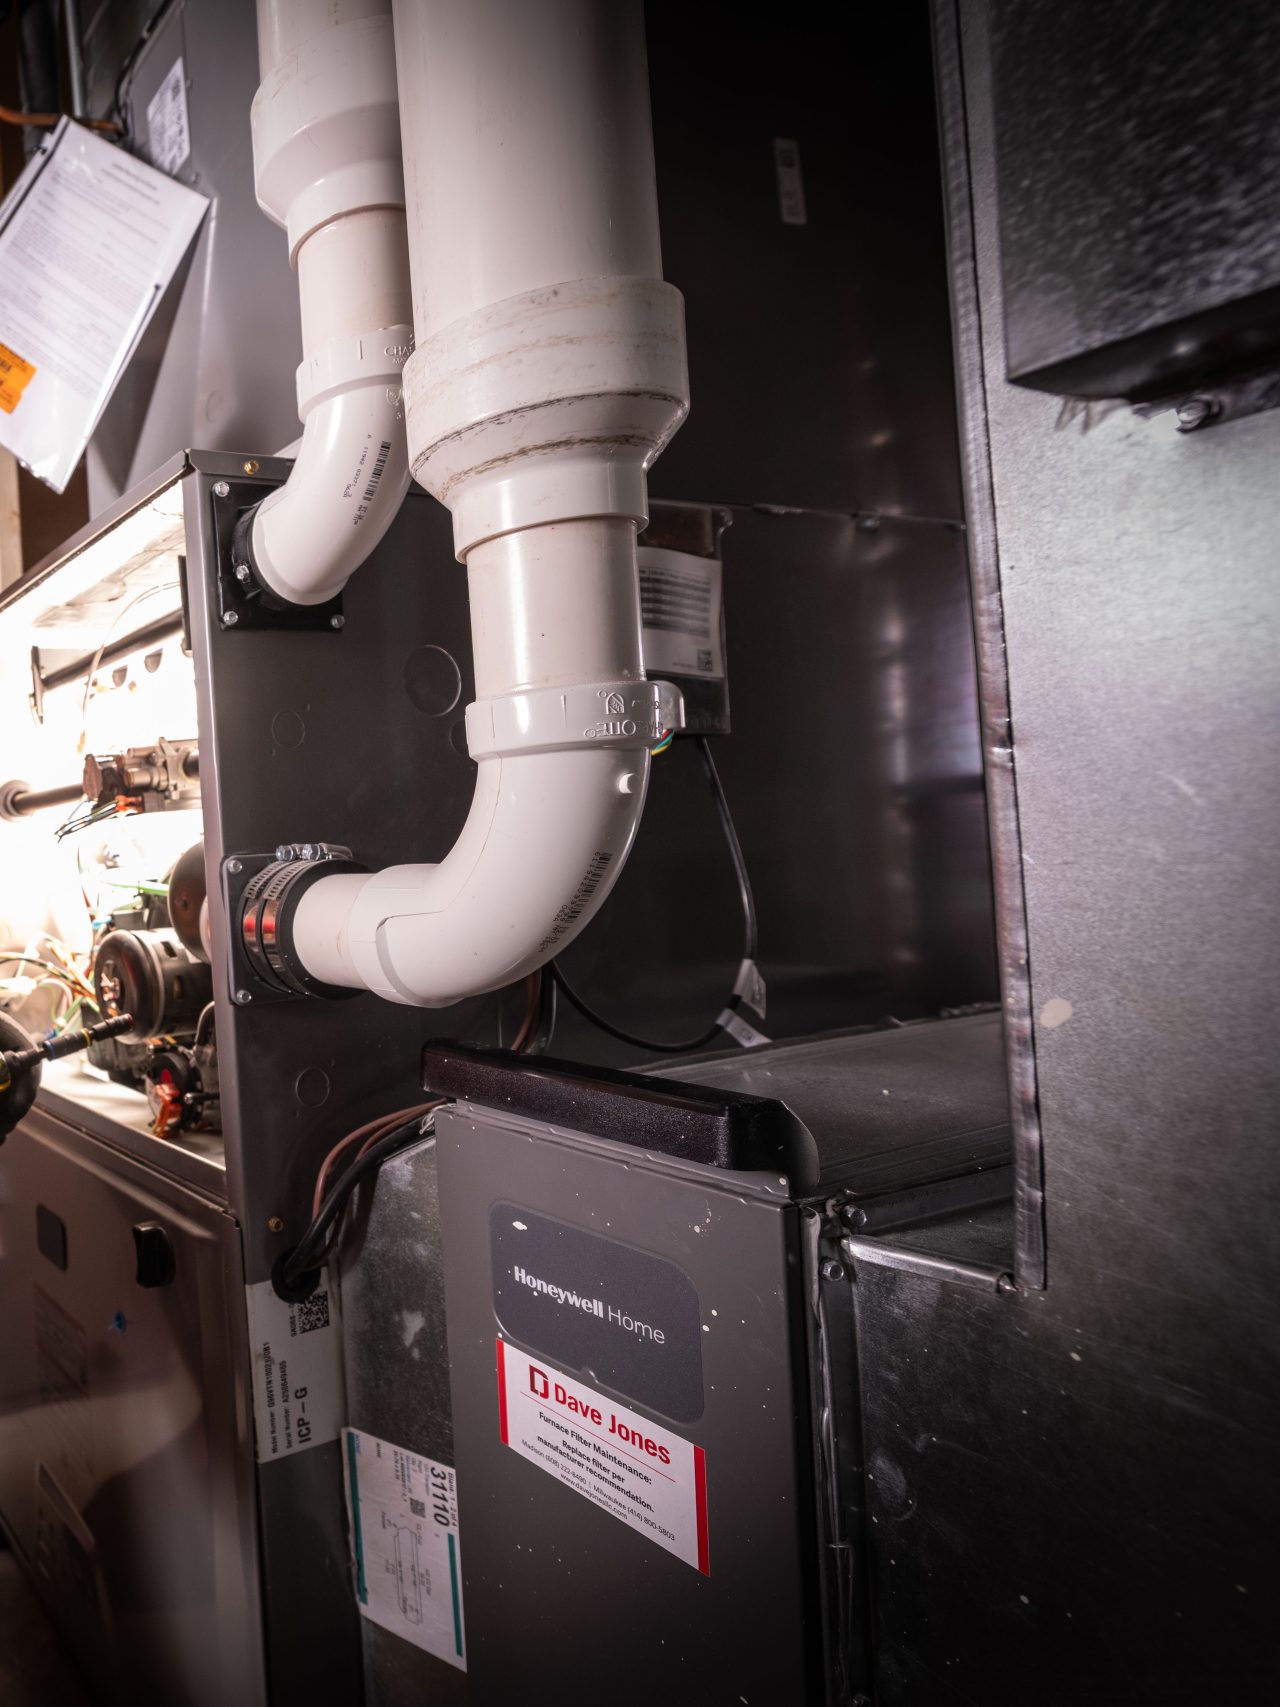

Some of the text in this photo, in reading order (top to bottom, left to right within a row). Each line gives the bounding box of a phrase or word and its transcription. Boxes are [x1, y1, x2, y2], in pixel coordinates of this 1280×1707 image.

[513, 1265, 666, 1344] Honeywell Home
[539, 1411, 652, 1485] Furnace Filter Maintenance:
[554, 1383, 602, 1426] Dave
[608, 1415, 671, 1465] Jones
[430, 1467, 450, 1527] 31110
[537, 1434, 655, 1513] manufacturer recommendation.
[562, 1438, 626, 1485] Replace filter per
[593, 1485, 627, 1511] Milwaukee
